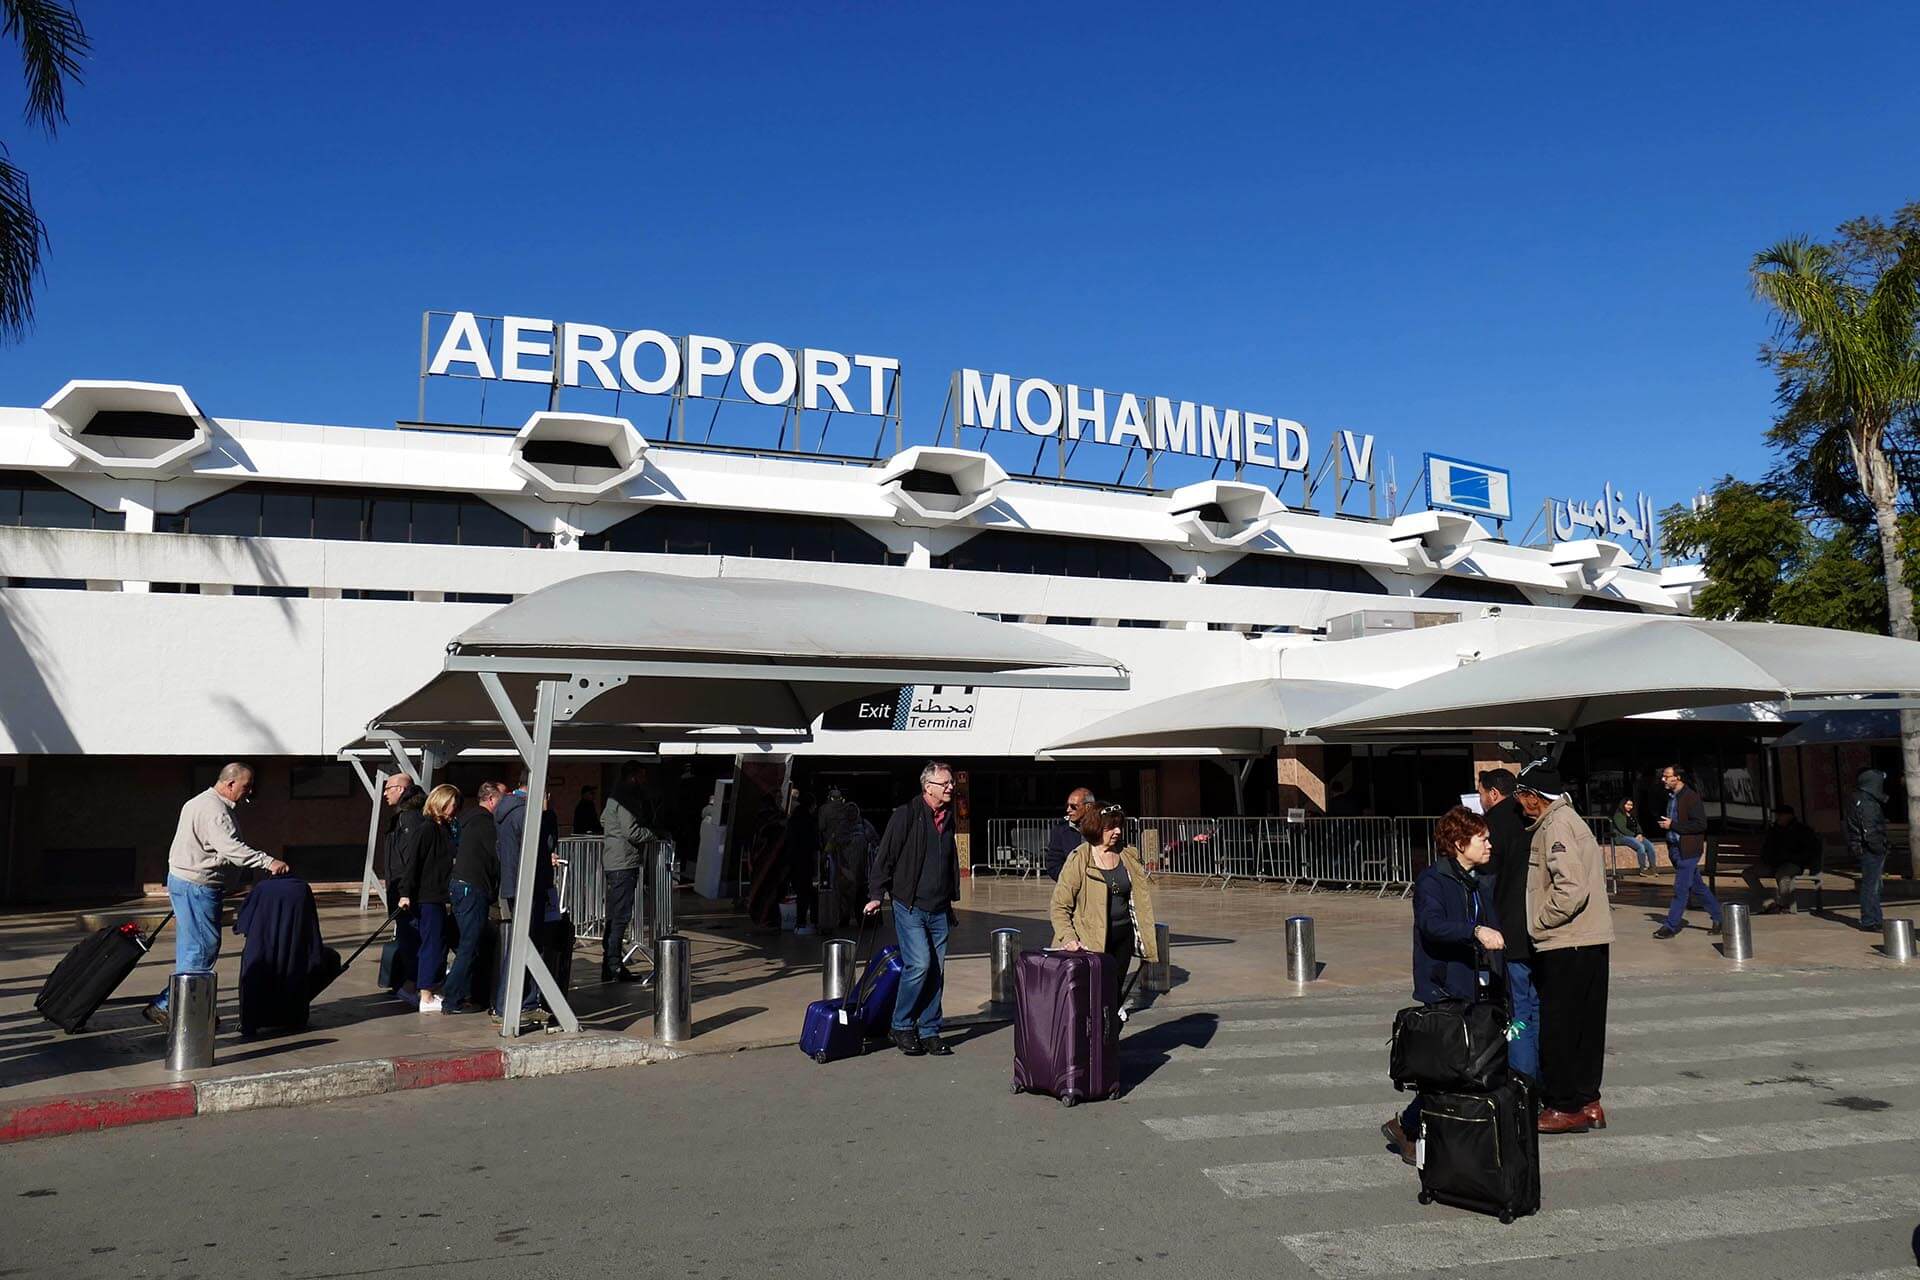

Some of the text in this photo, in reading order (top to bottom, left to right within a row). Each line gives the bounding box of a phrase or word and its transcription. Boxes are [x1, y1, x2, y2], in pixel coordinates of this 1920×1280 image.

[428, 311, 1374, 481] AEROPORT MOHAMMED V
[1554, 480, 1653, 547] الخامس
[859, 703, 891, 718] Exit
[912, 699, 974, 713] محطة
[909, 716, 973, 729] Terminal
